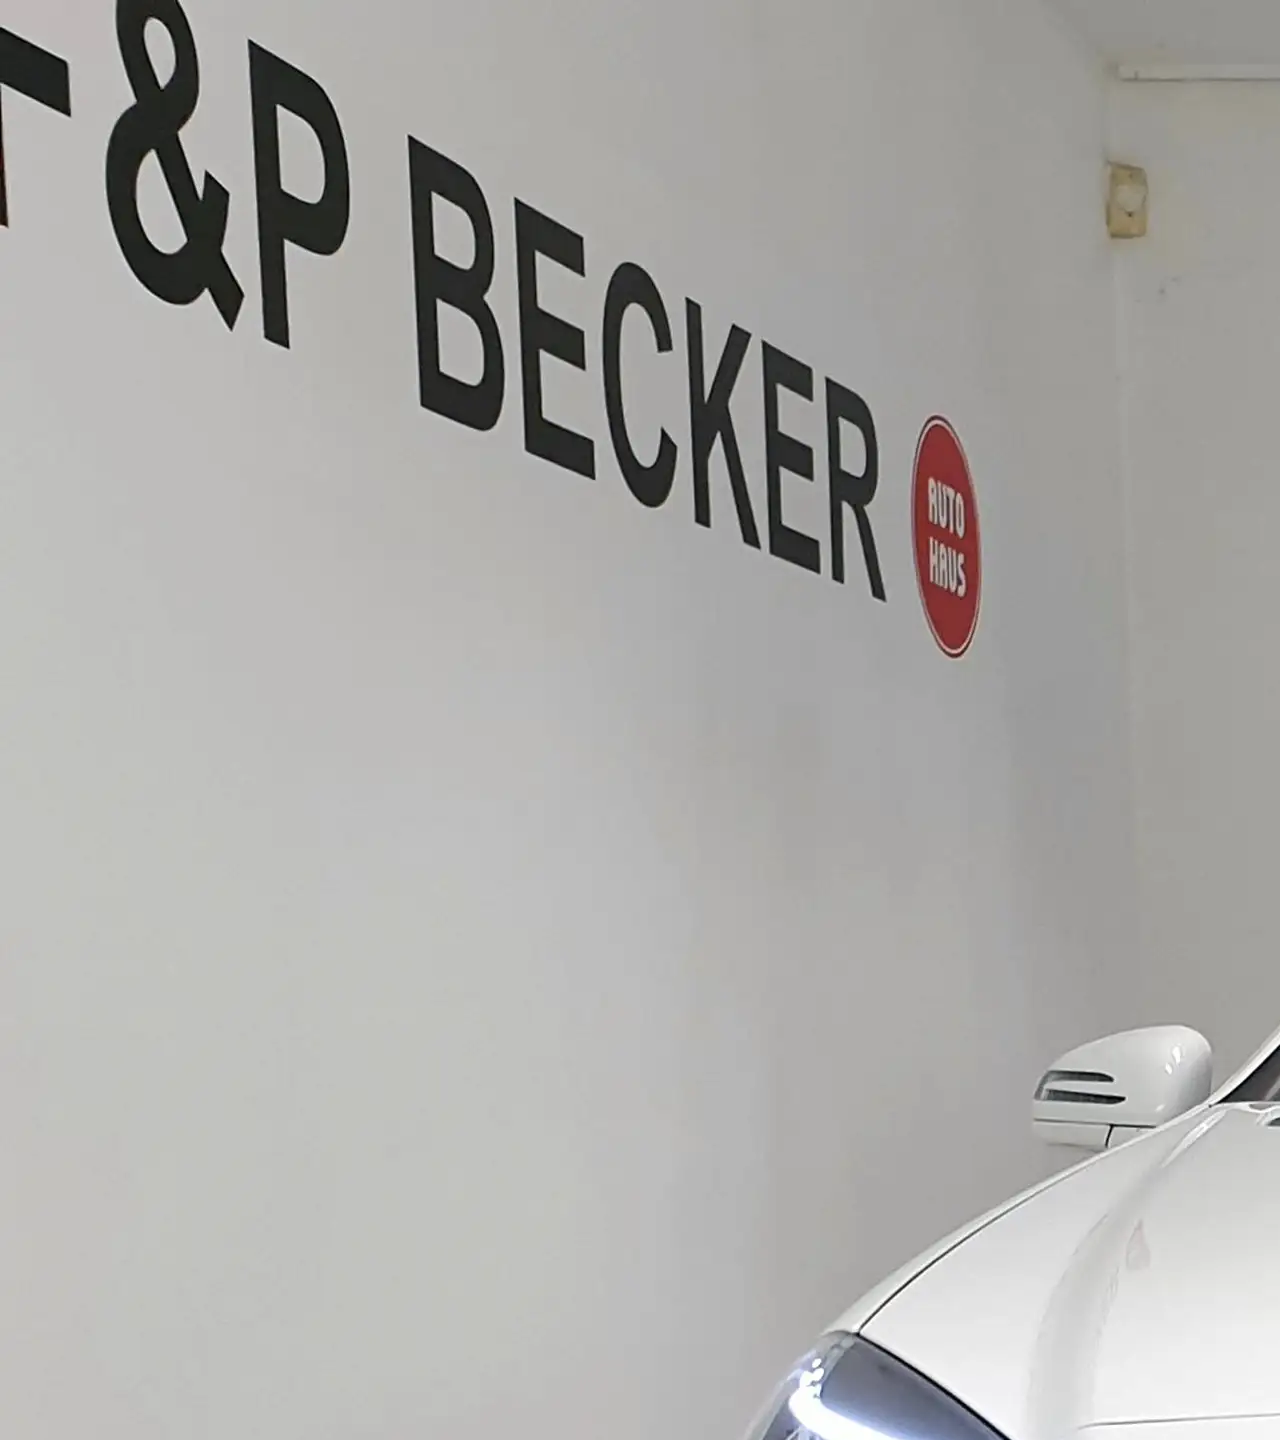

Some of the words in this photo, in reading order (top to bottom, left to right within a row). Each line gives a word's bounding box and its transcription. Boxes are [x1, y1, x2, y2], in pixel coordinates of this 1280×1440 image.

[408, 135, 887, 603] BECKER
[927, 477, 966, 540] AUTO
[929, 536, 967, 598] HAUS
